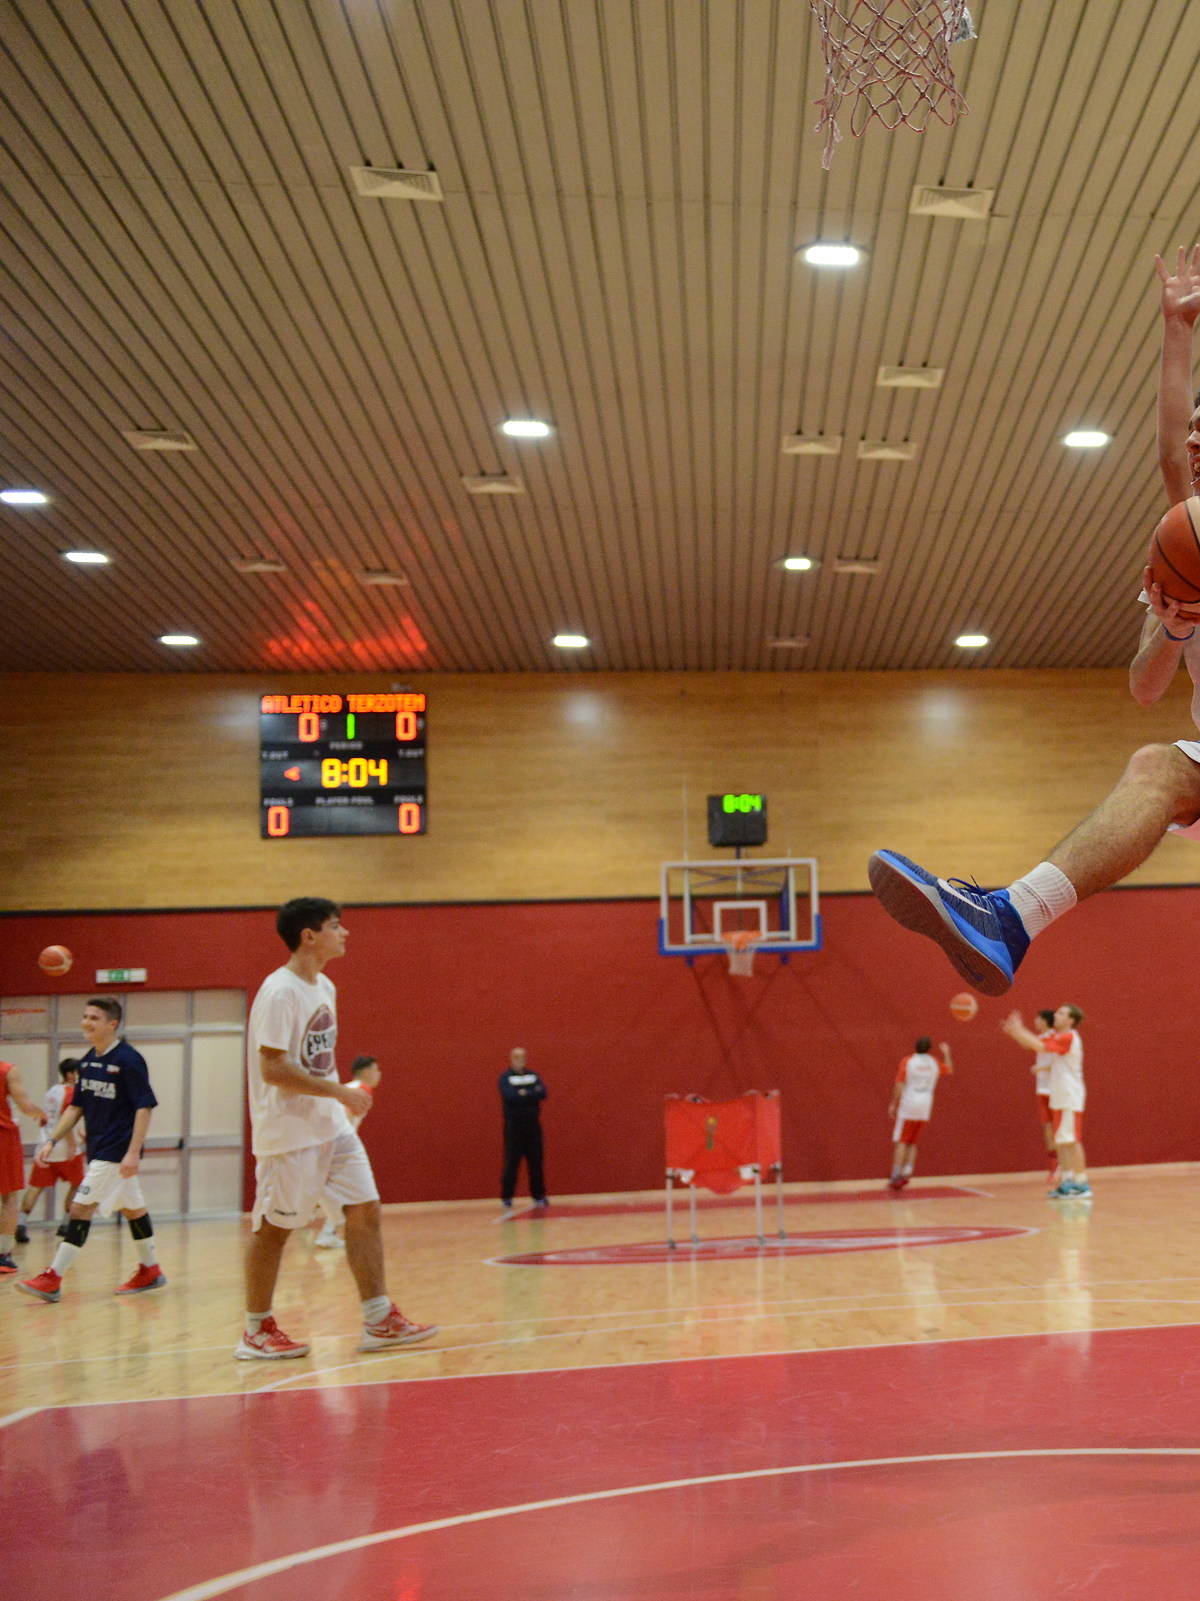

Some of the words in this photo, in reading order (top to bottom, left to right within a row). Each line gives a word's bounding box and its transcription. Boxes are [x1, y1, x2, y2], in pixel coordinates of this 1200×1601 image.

[261, 695, 343, 713] ATLETICO
[298, 712, 320, 742] 0
[346, 713, 356, 740] 1
[395, 711, 417, 741] 0
[321, 757, 389, 788] 8:04
[267, 805, 290, 837] 0
[398, 803, 421, 834] 0
